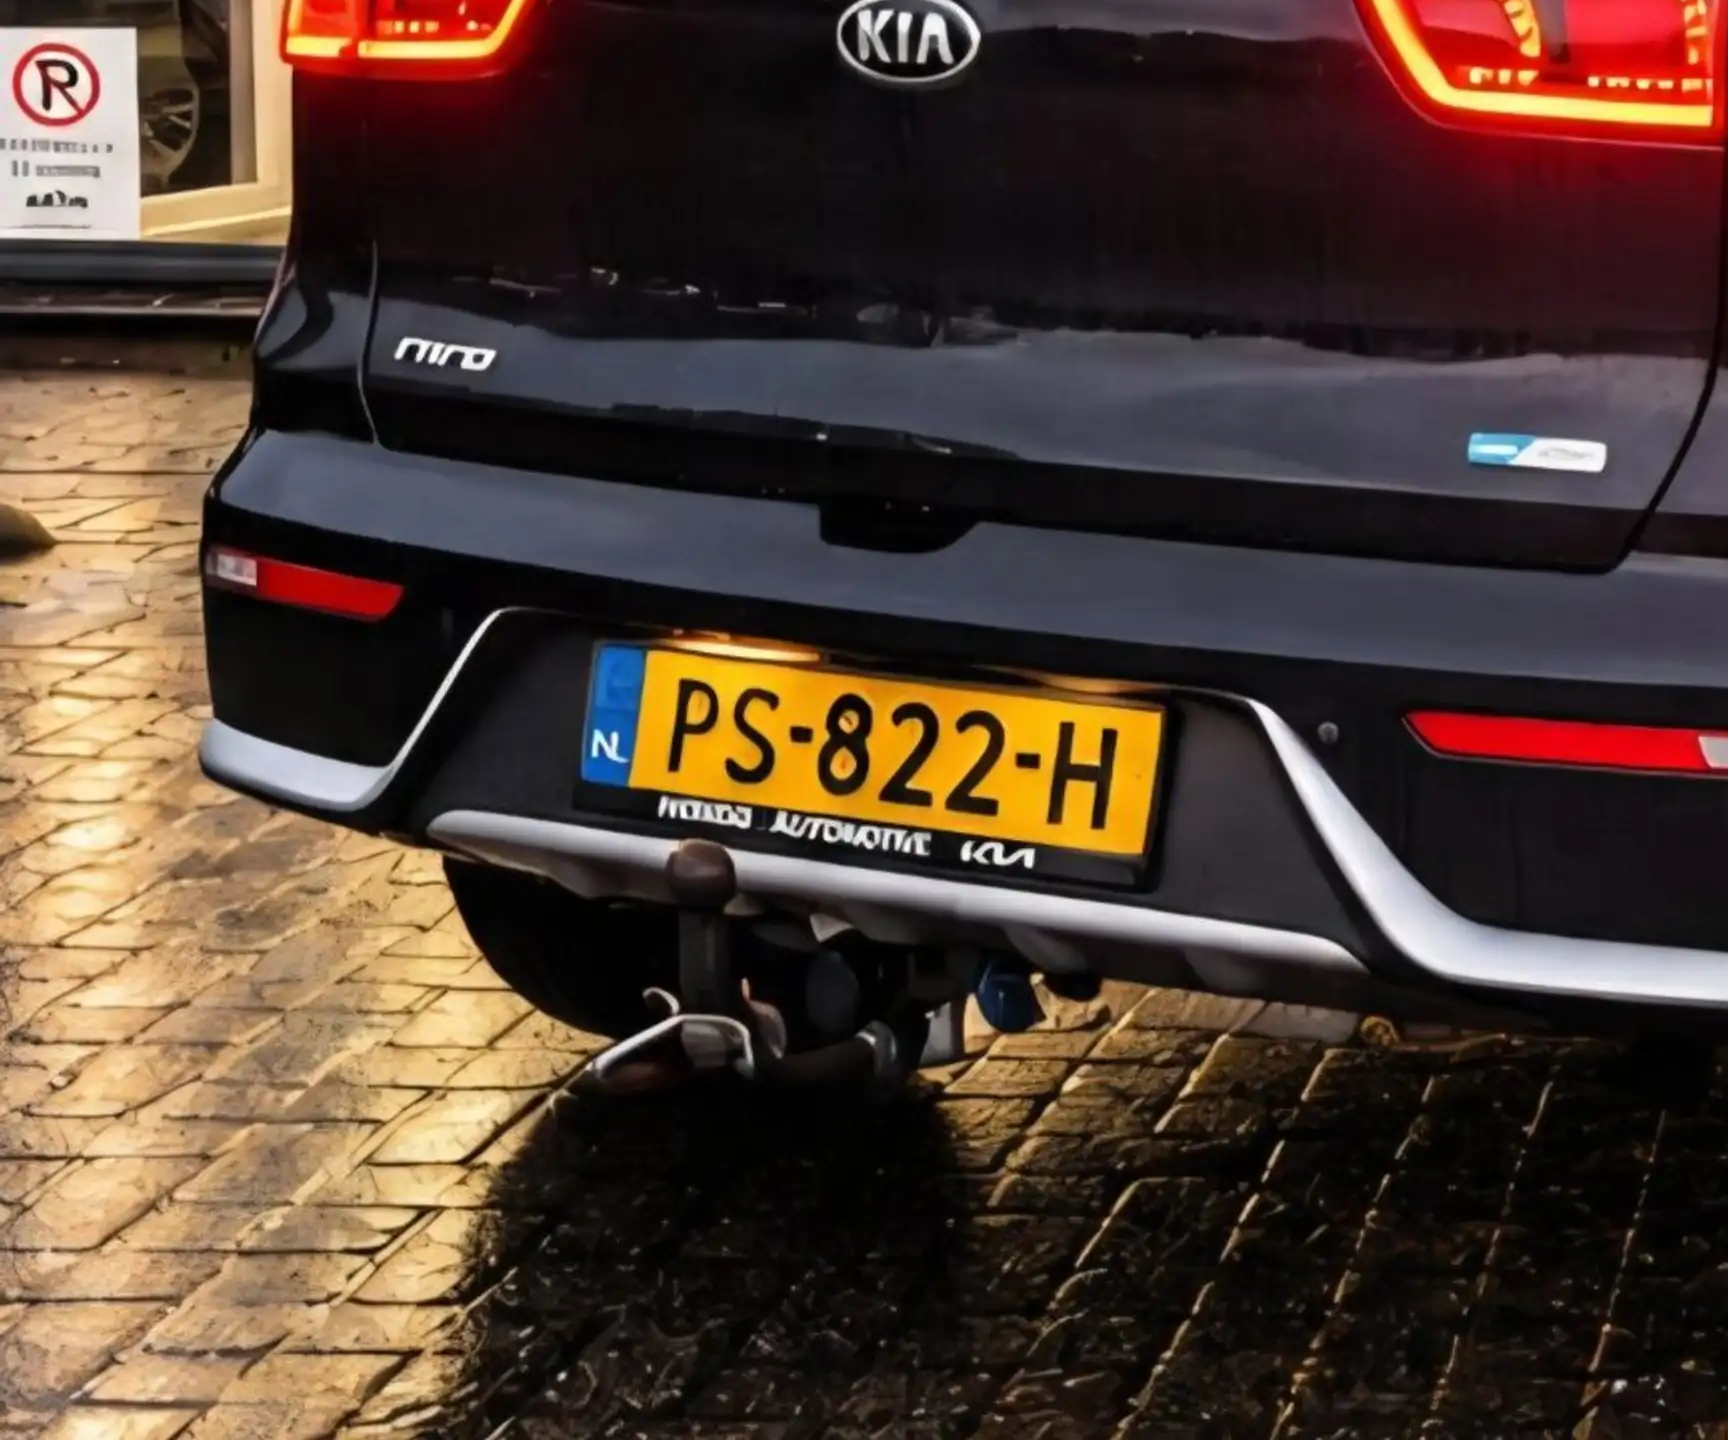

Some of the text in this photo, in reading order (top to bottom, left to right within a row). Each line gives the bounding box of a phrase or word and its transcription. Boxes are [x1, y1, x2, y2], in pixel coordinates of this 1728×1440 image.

[857, 8, 955, 64] KIA
[394, 336, 497, 371] niro
[591, 728, 630, 763] NL
[667, 678, 1119, 830] PS-822-H
